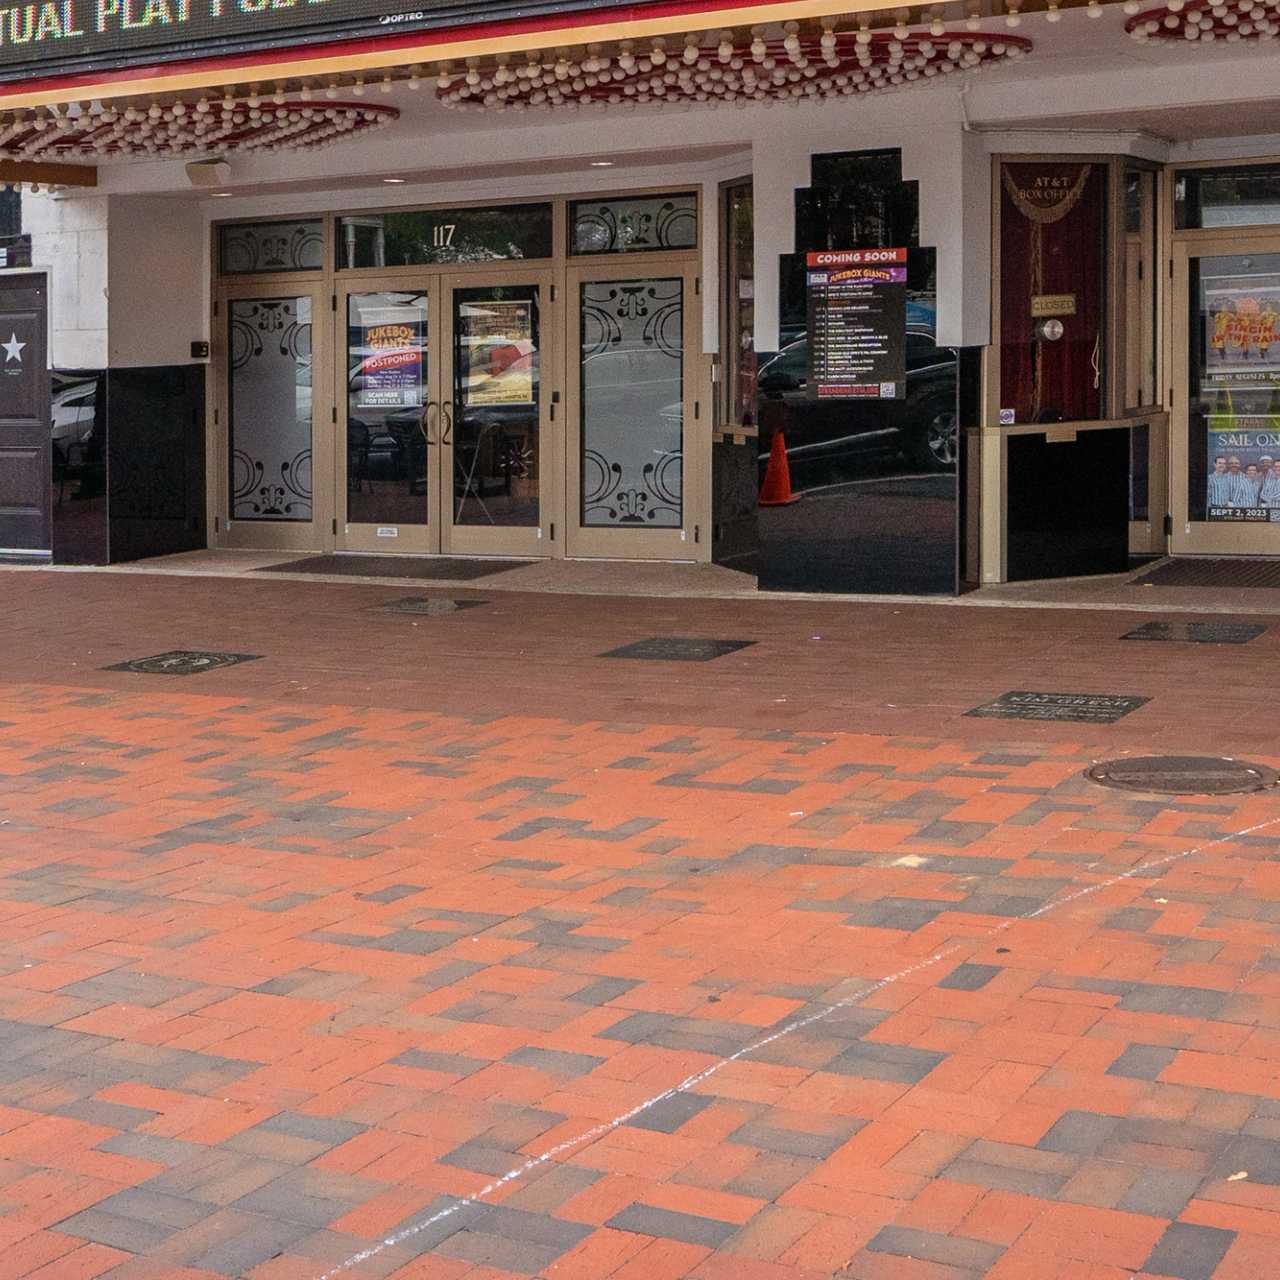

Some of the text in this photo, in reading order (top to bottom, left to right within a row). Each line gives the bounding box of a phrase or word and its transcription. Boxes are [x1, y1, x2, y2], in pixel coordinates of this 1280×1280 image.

[433, 224, 456, 246] 117
[817, 251, 897, 264] COMING SOON
[367, 325, 415, 341] JUKEBOX
[365, 352, 417, 368] POSTPONED
[1218, 433, 1280, 447] SAIL ON
[1246, 508, 1267, 516] 2023
